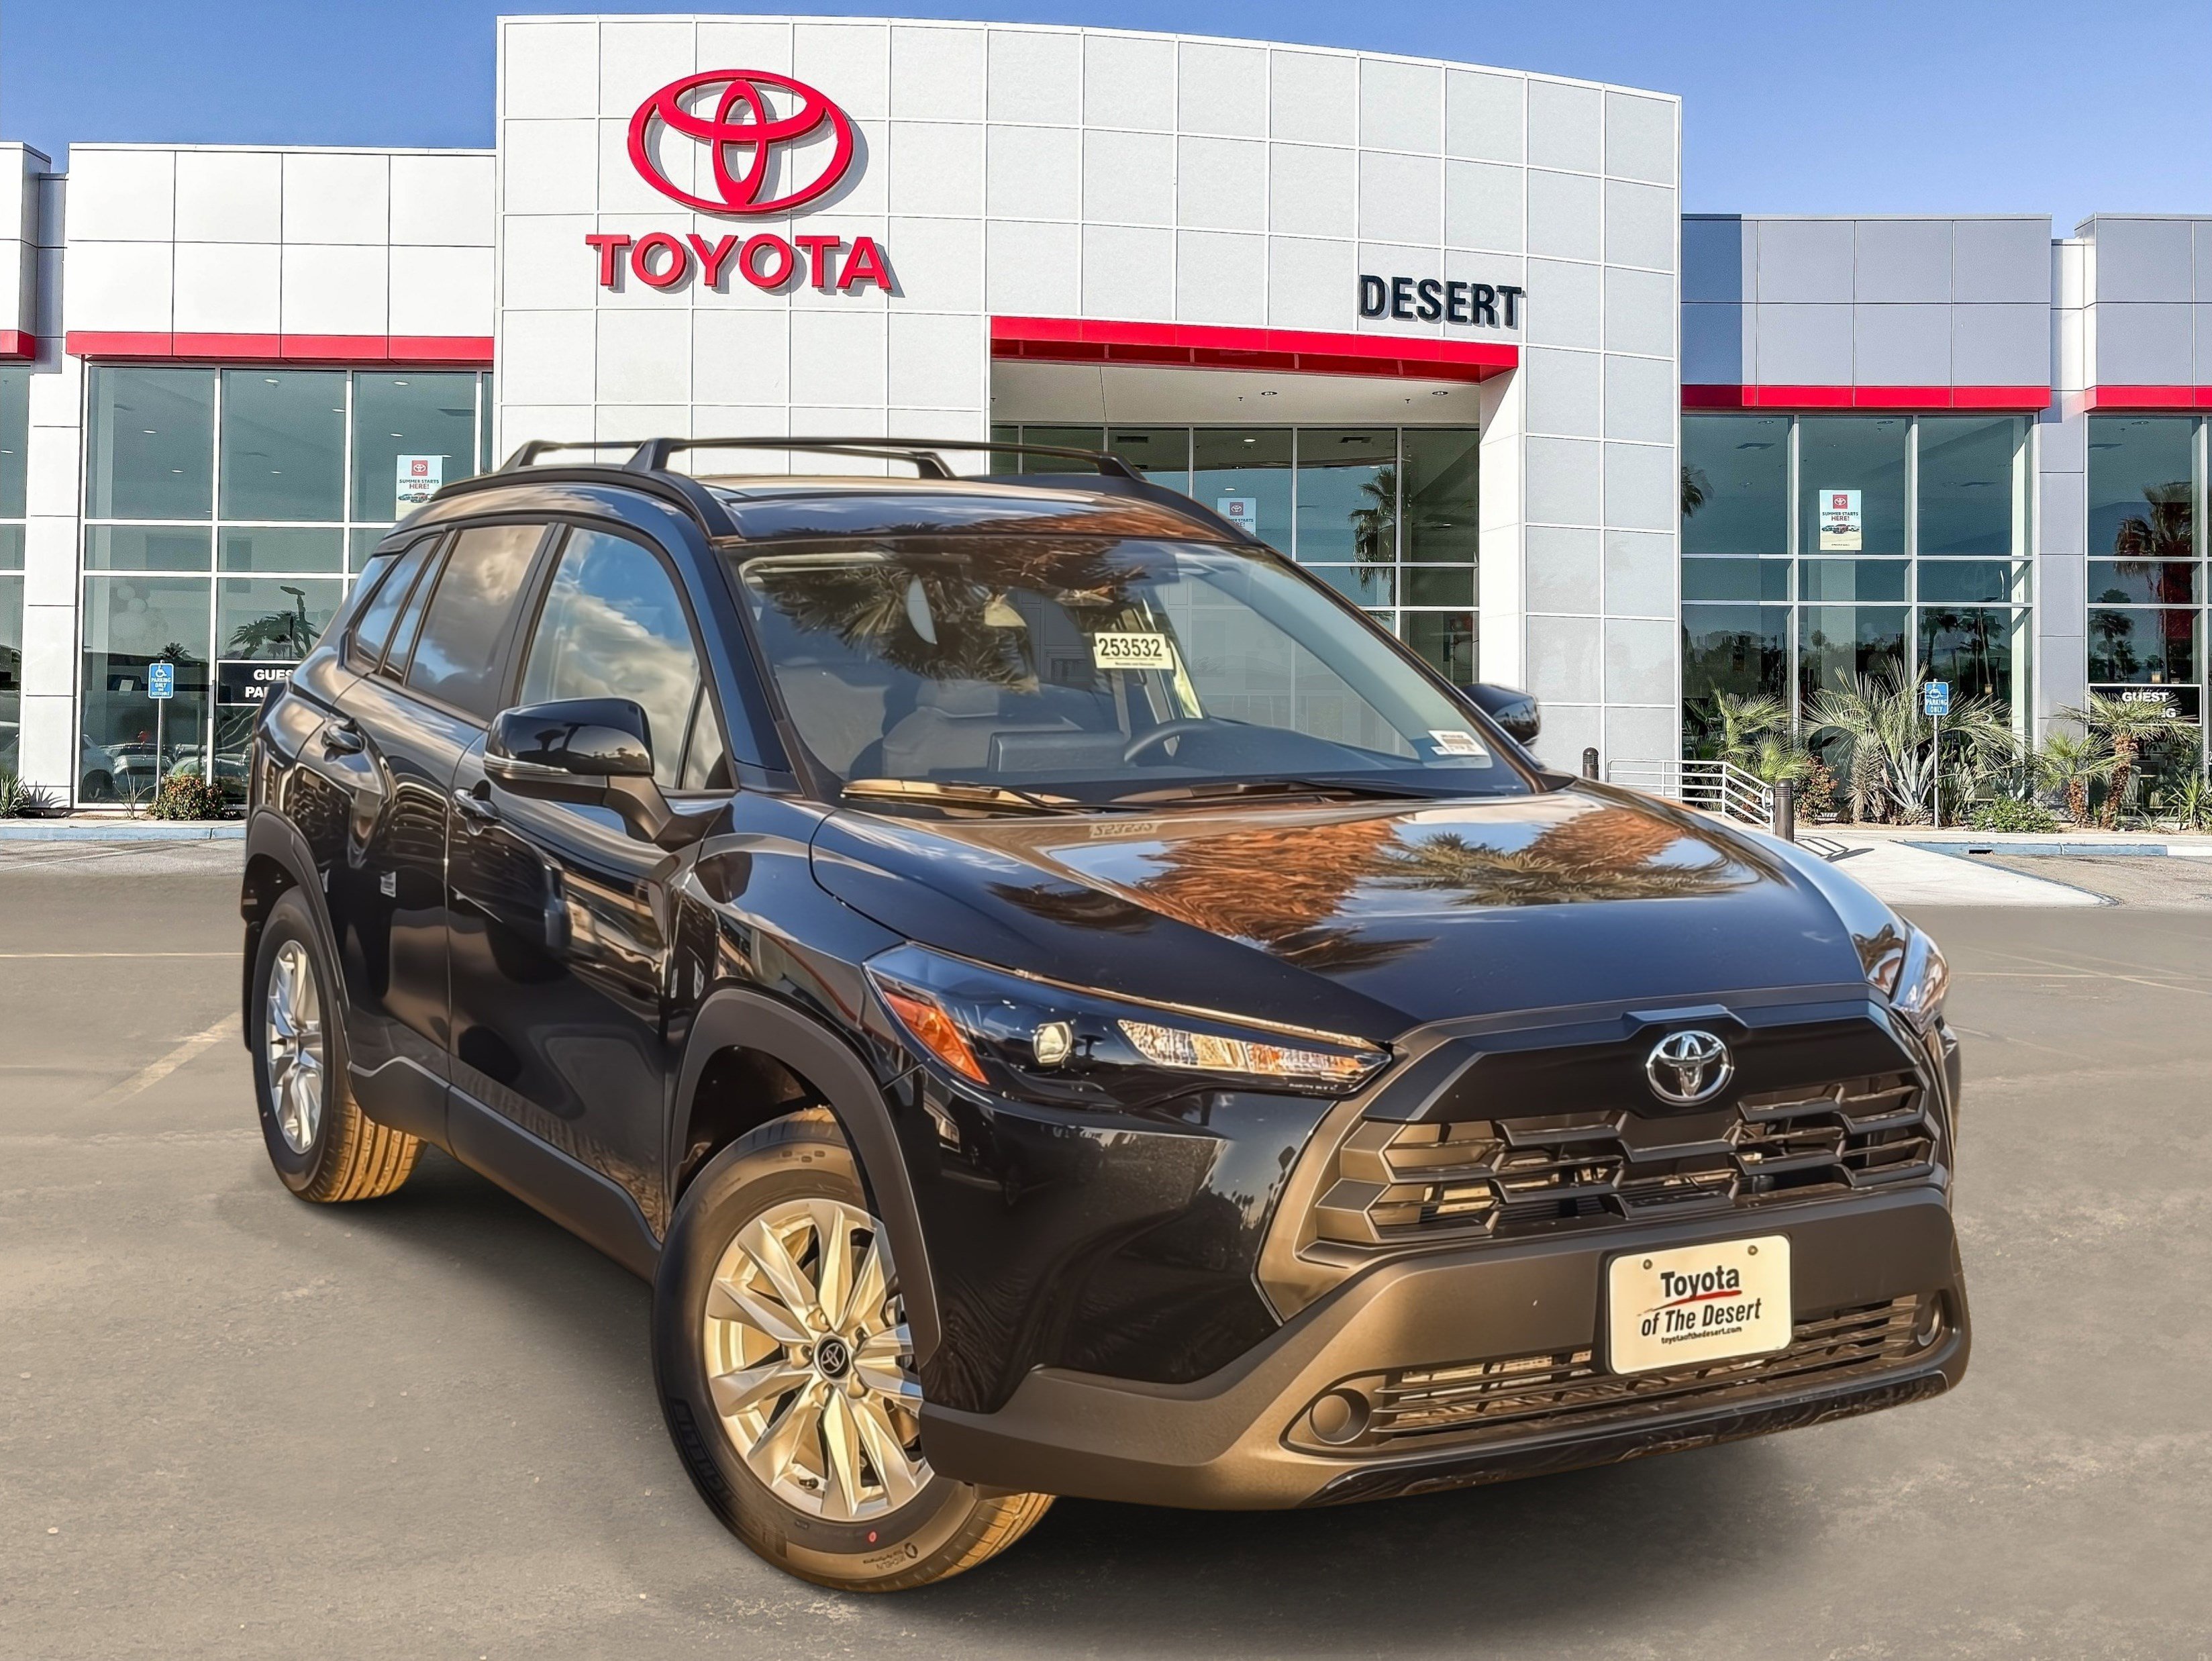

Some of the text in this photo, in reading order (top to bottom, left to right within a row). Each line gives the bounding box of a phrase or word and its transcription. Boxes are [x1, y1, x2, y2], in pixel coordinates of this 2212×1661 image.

[585, 232, 893, 290] TOYOTA
[1359, 274, 1522, 327] DESERT
[1099, 638, 1162, 657] 253532
[1926, 698, 1947, 706] PARKING
[2121, 691, 2169, 703] GUEST
[1930, 705, 1943, 713] ONLY
[1660, 1265, 1740, 1300] Toyota
[1641, 1297, 1762, 1337] of The Desert
[1660, 1326, 1742, 1345] toyotaofthedesert.com
